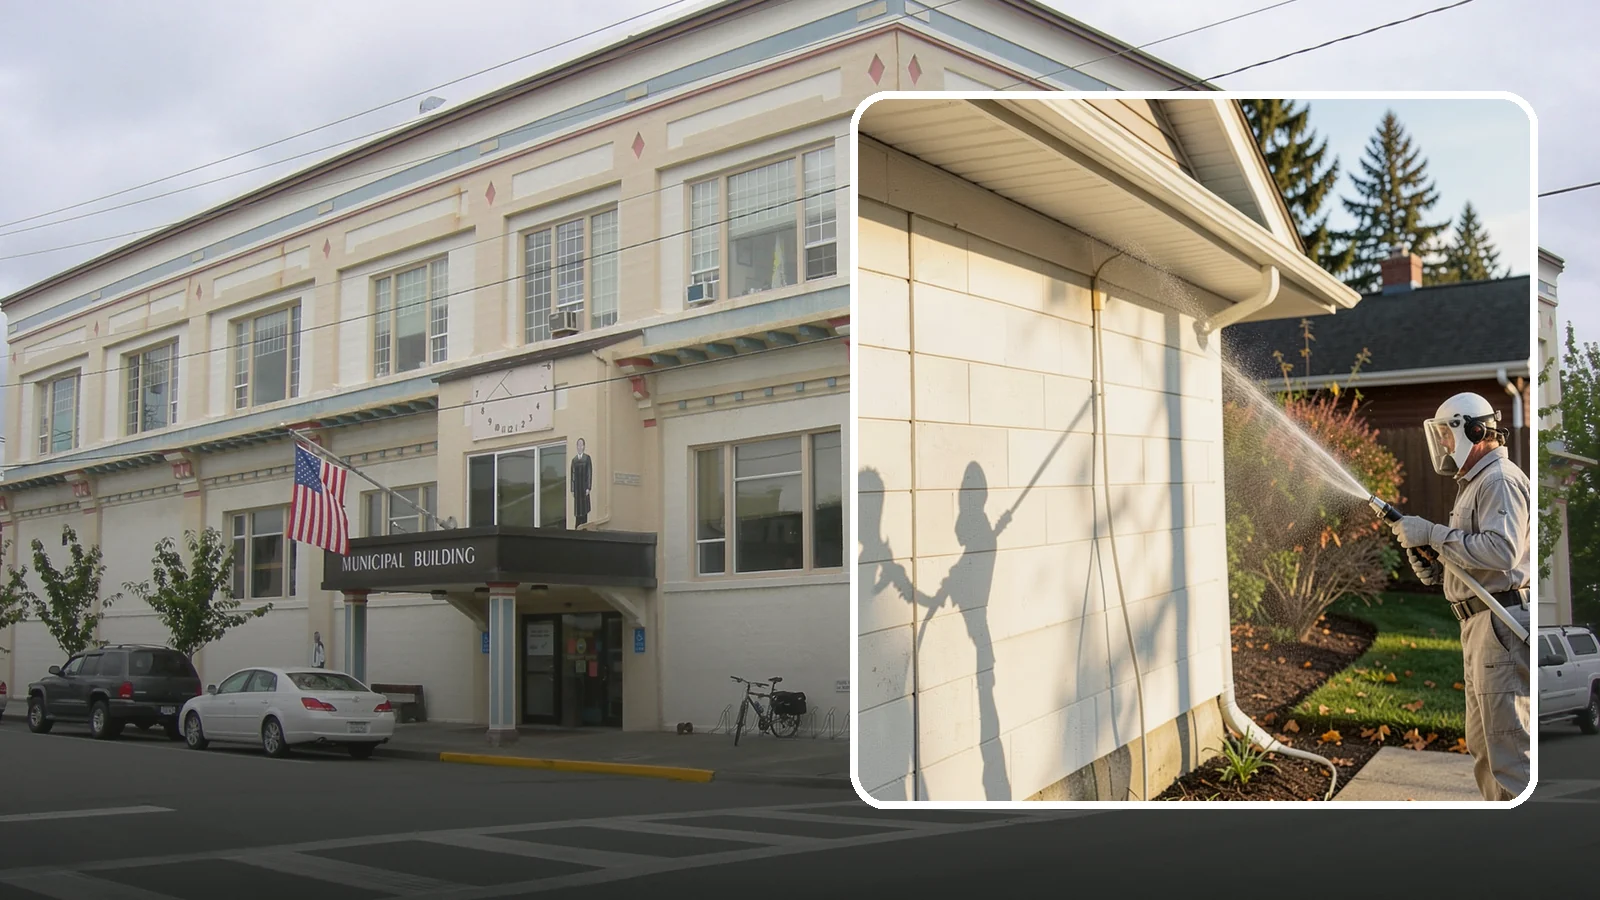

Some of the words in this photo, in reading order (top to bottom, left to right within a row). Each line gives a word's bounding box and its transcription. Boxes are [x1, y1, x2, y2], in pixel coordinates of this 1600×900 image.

[480, 407, 485, 415] 8
[487, 417, 492, 425] 9
[528, 414, 533, 422] 3
[521, 420, 526, 428] 2
[494, 424, 500, 432] 10
[507, 425, 513, 433] 12
[342, 552, 405, 572] MUNICIPAL
[414, 546, 475, 567] BUILDING
